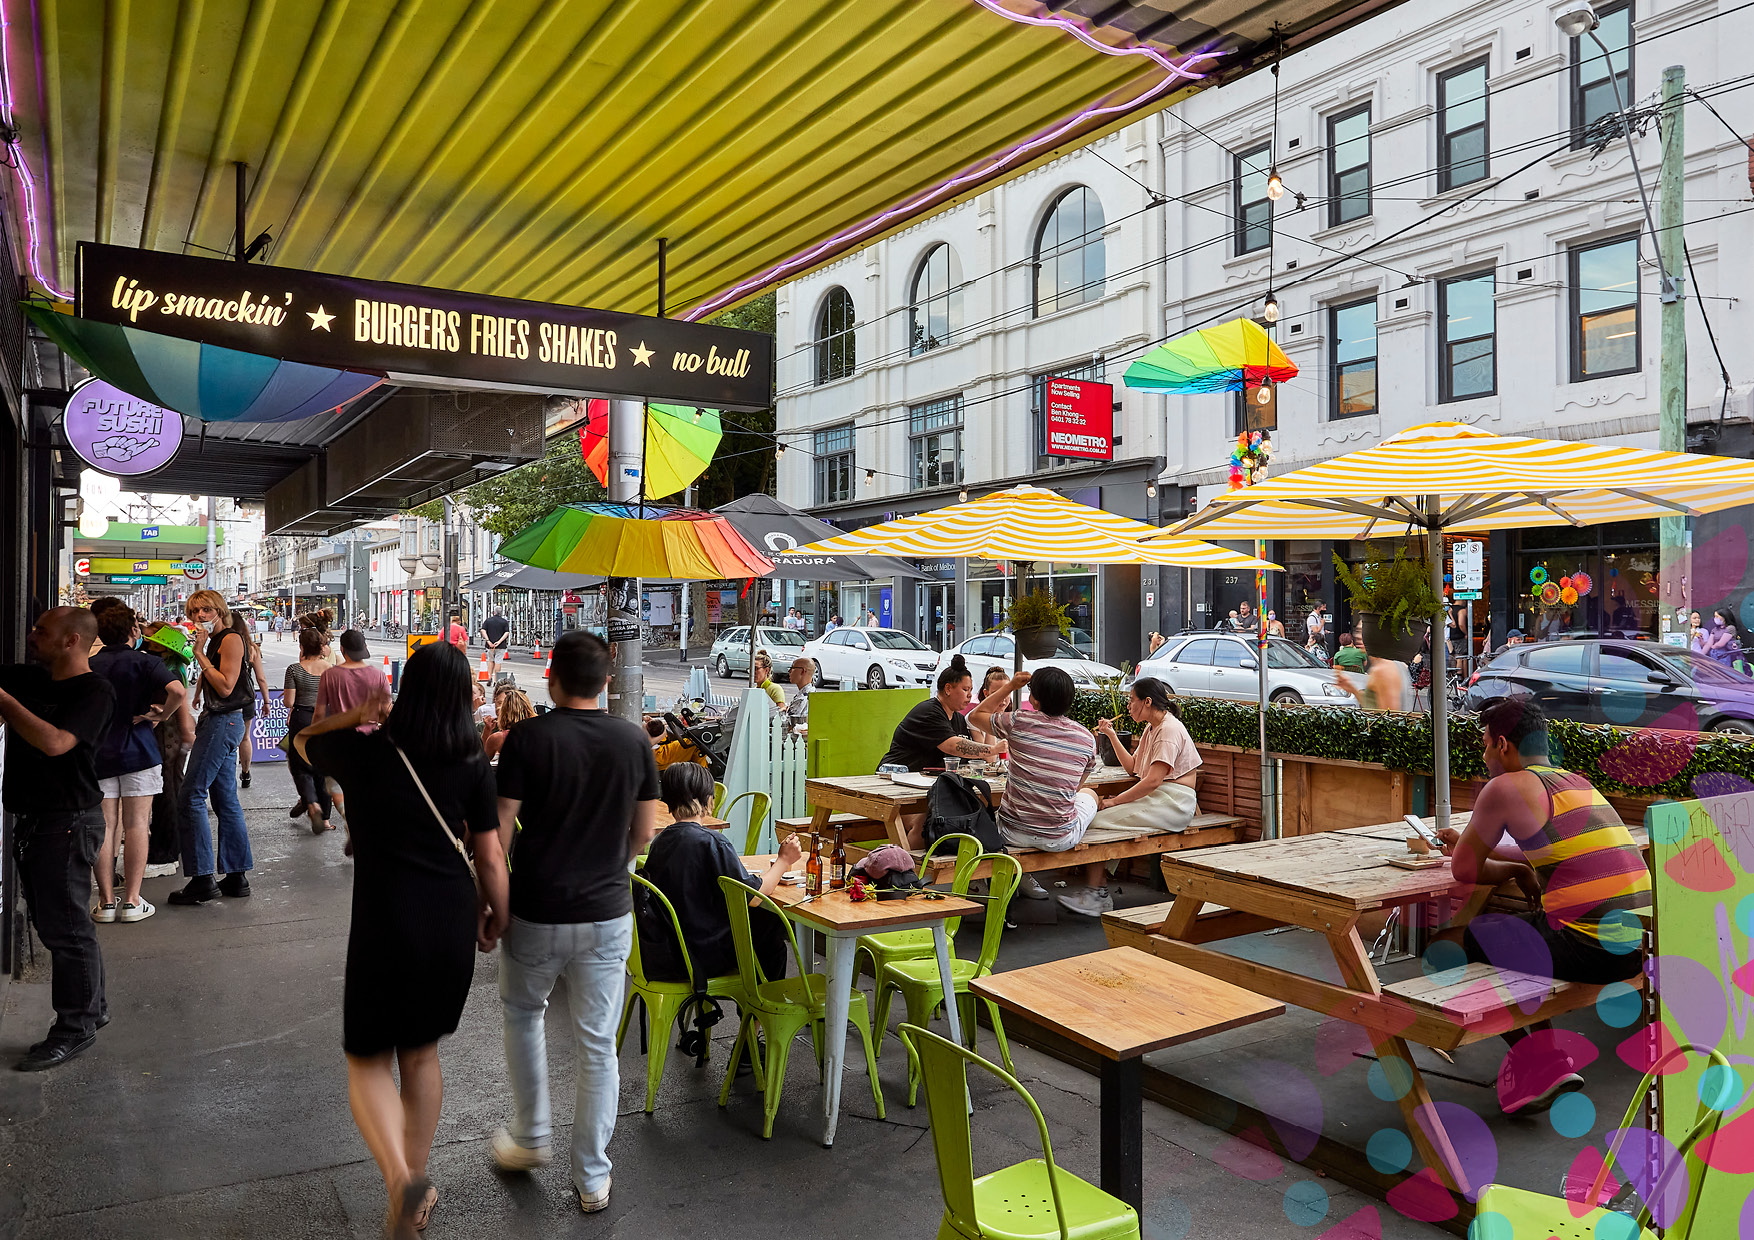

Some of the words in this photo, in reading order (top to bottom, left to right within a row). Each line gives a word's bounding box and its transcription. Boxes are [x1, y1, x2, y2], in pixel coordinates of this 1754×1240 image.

[110, 275, 159, 323] lip
[160, 291, 293, 328] smackin'
[354, 299, 461, 352] BURGERS
[470, 313, 530, 361] FRIES
[539, 322, 617, 370] SHAKES
[671, 349, 704, 373] no
[705, 345, 752, 379] bull
[1051, 382, 1081, 391] Apartments
[1064, 390, 1081, 400] Selling
[82, 398, 163, 418] FUTURE
[1051, 402, 1072, 410] Contact
[97, 415, 163, 435] SUSHI
[1051, 432, 1108, 448] NEOMETRO.
[142, 529, 158, 537] TAB
[1454, 543, 1467, 552] 2P
[772, 556, 836, 565] RADURA
[133, 563, 148, 571] TAB
[921, 563, 933, 572] Bank
[933, 563, 939, 572] of
[1143, 578, 1157, 586] 231
[1225, 576, 1238, 584] 237
[1455, 573, 1467, 582] 6P
[253, 719, 269, 738] &
[264, 719, 288, 729] GOOD
